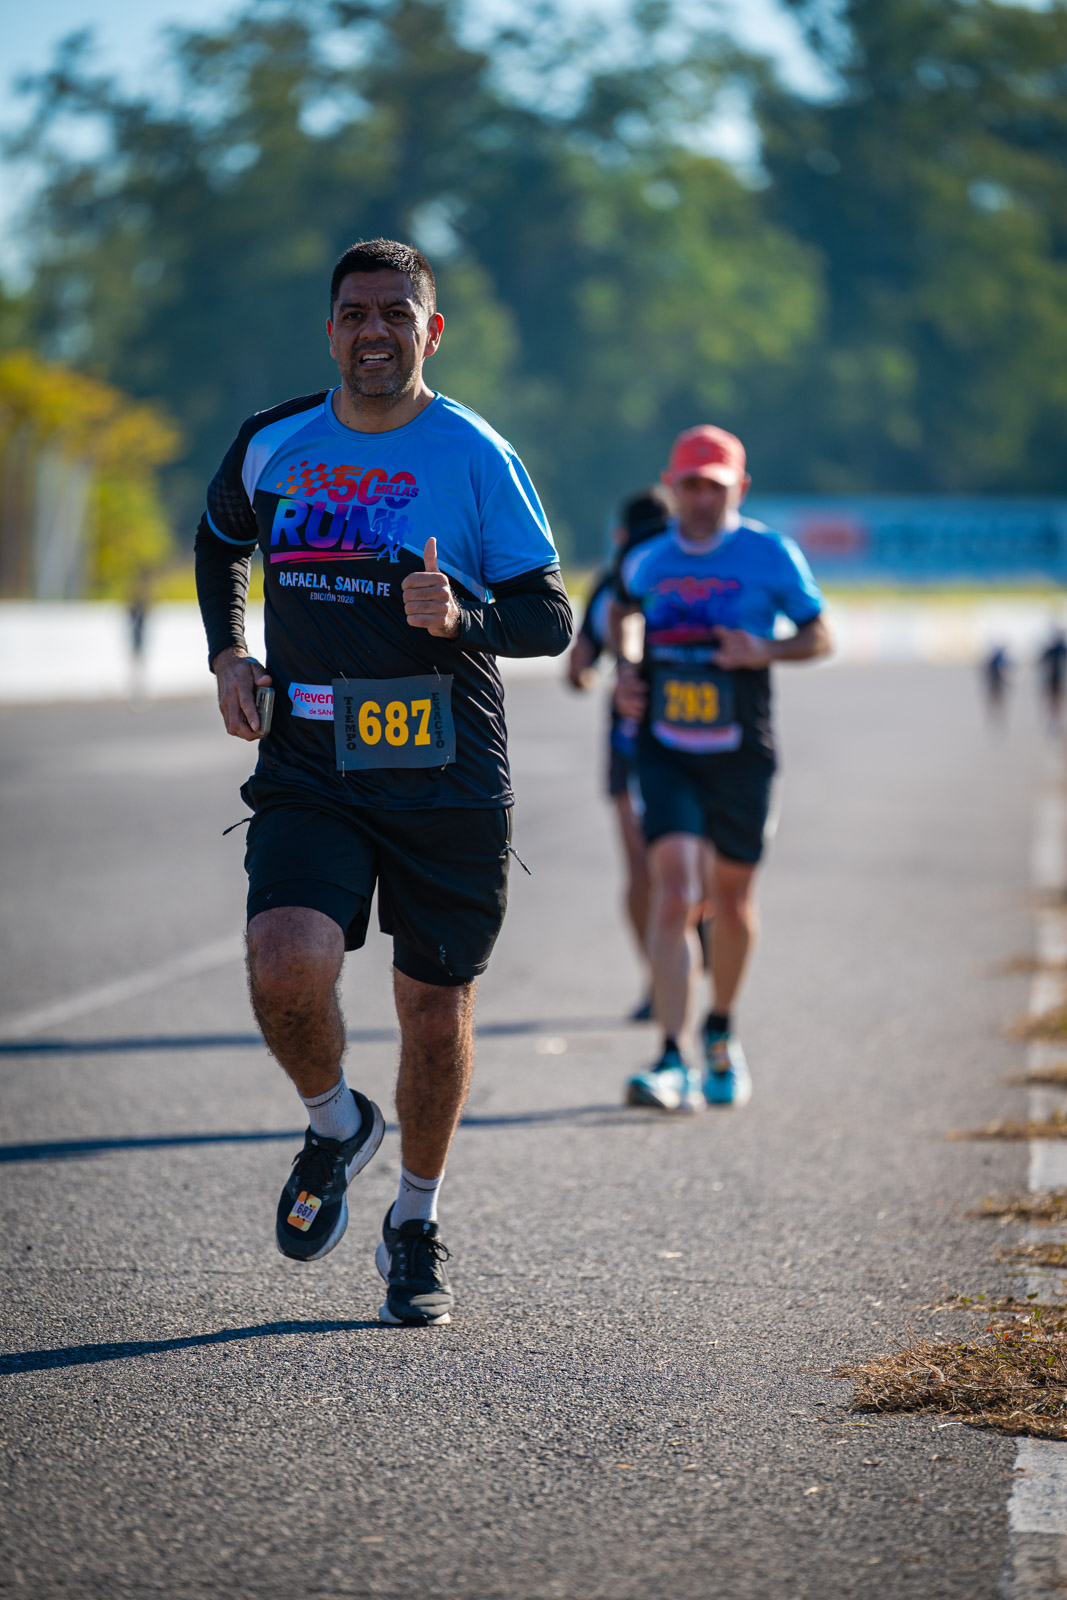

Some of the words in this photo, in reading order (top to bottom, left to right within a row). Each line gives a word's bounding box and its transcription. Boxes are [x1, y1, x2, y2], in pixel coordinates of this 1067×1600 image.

[374, 483, 419, 498] MILLAS
[270, 498, 388, 551] RUN
[279, 571, 331, 590] RAFAELA,
[334, 575, 374, 595] SANTA
[376, 582, 391, 597] FE
[310, 591, 336, 602] EDICIÓN
[343, 696, 357, 751] TIEMPO
[358, 698, 432, 747] 687
[431, 692, 445, 749] EXACTO
[296, 1203, 313, 1218] 687
